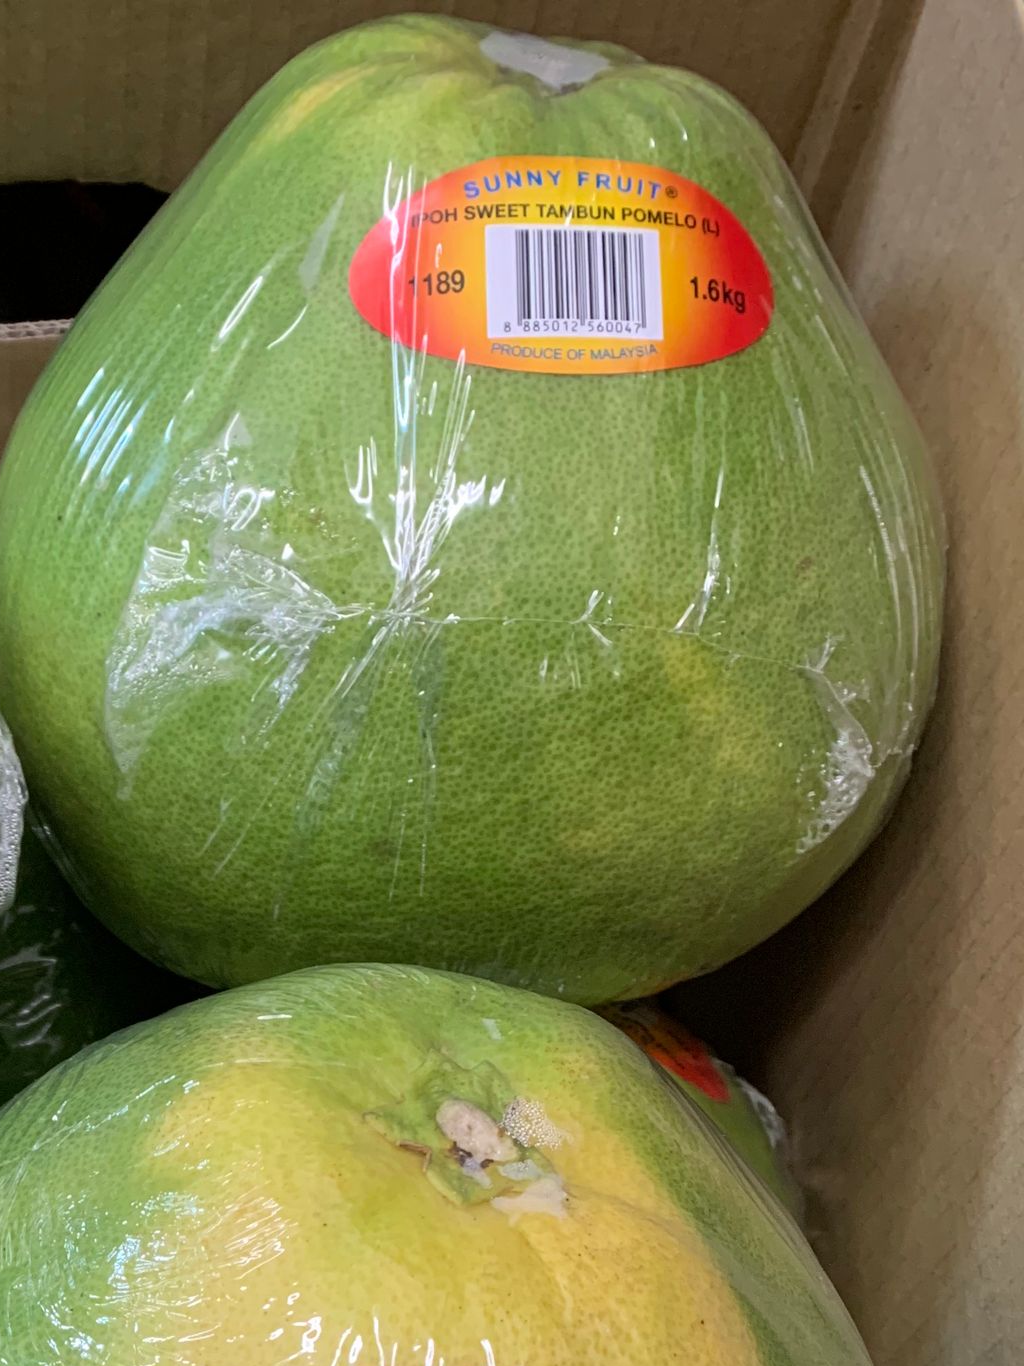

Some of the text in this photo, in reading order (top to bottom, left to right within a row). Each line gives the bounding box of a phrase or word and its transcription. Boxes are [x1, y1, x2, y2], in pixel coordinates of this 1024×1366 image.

[463, 169, 561, 199] SUNNY
[411, 203, 721, 238] IPOH SWEET TAMBUN POMELO (L)
[408, 269, 466, 296] 1189
[690, 276, 747, 314] 1.6kg
[503, 320, 642, 335] 8 885012 560047
[491, 343, 659, 361] PRODUCE OF MALAYSIA
